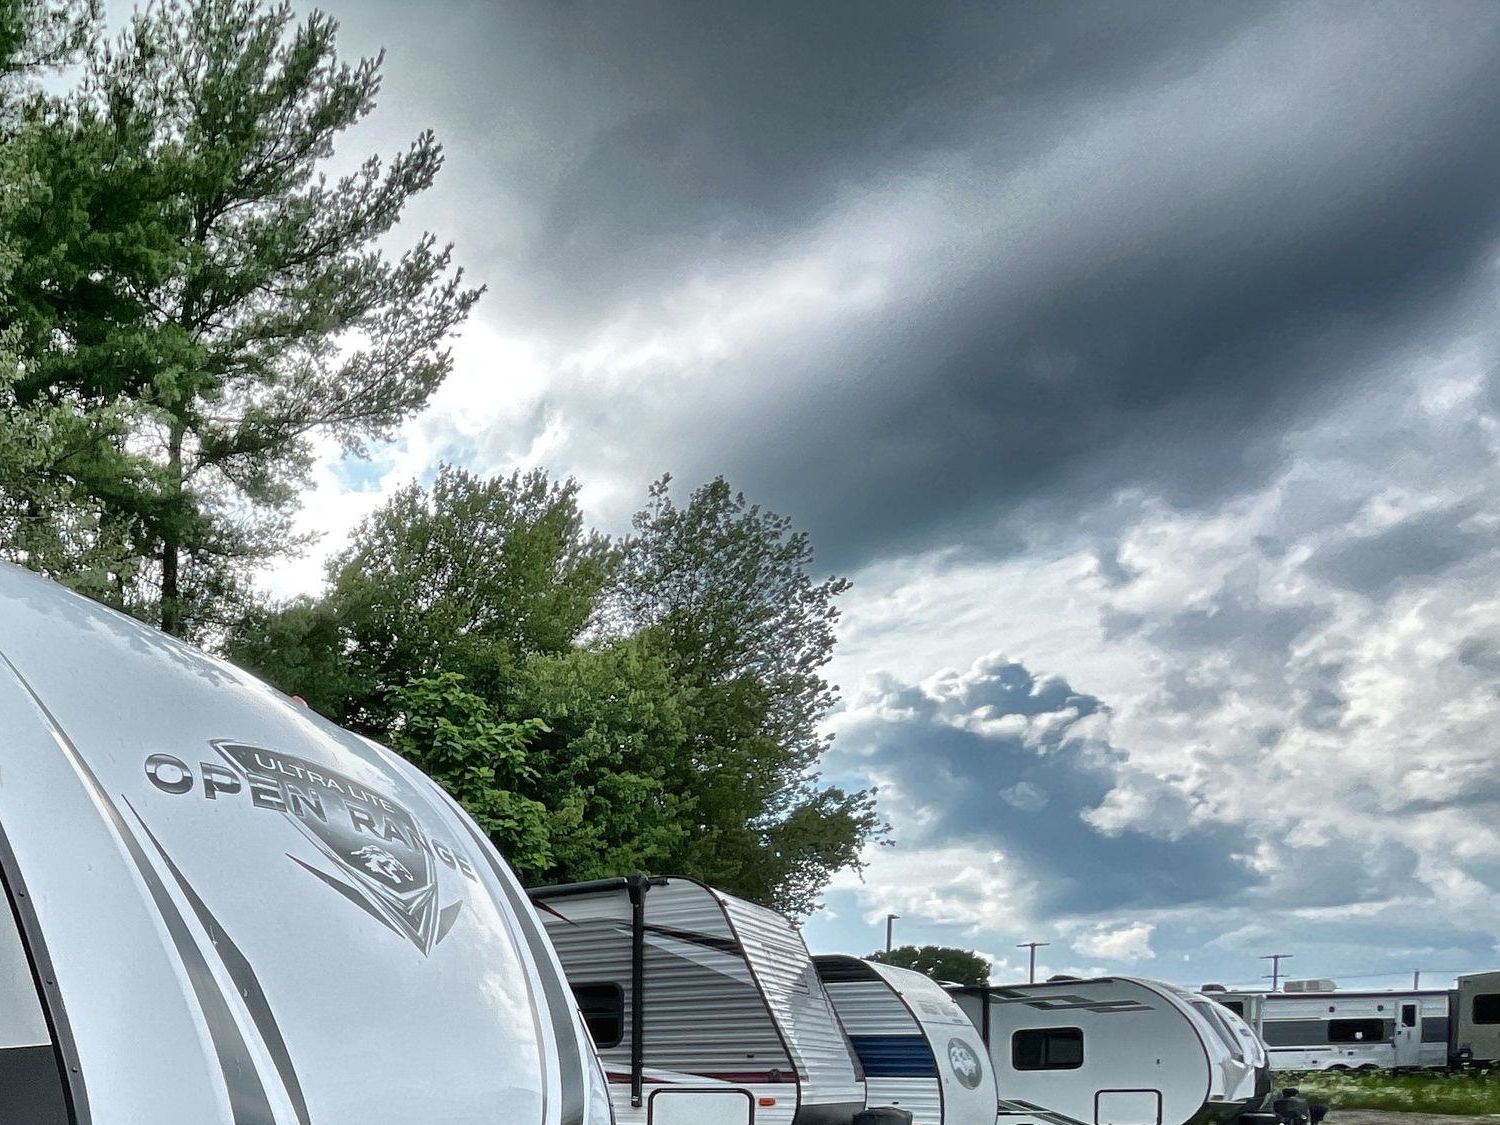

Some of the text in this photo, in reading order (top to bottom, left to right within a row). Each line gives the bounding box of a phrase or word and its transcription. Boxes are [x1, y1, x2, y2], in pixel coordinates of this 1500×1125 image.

[144, 753, 478, 883] OPEN RANGE
[254, 753, 395, 813] ULTRA LITE
